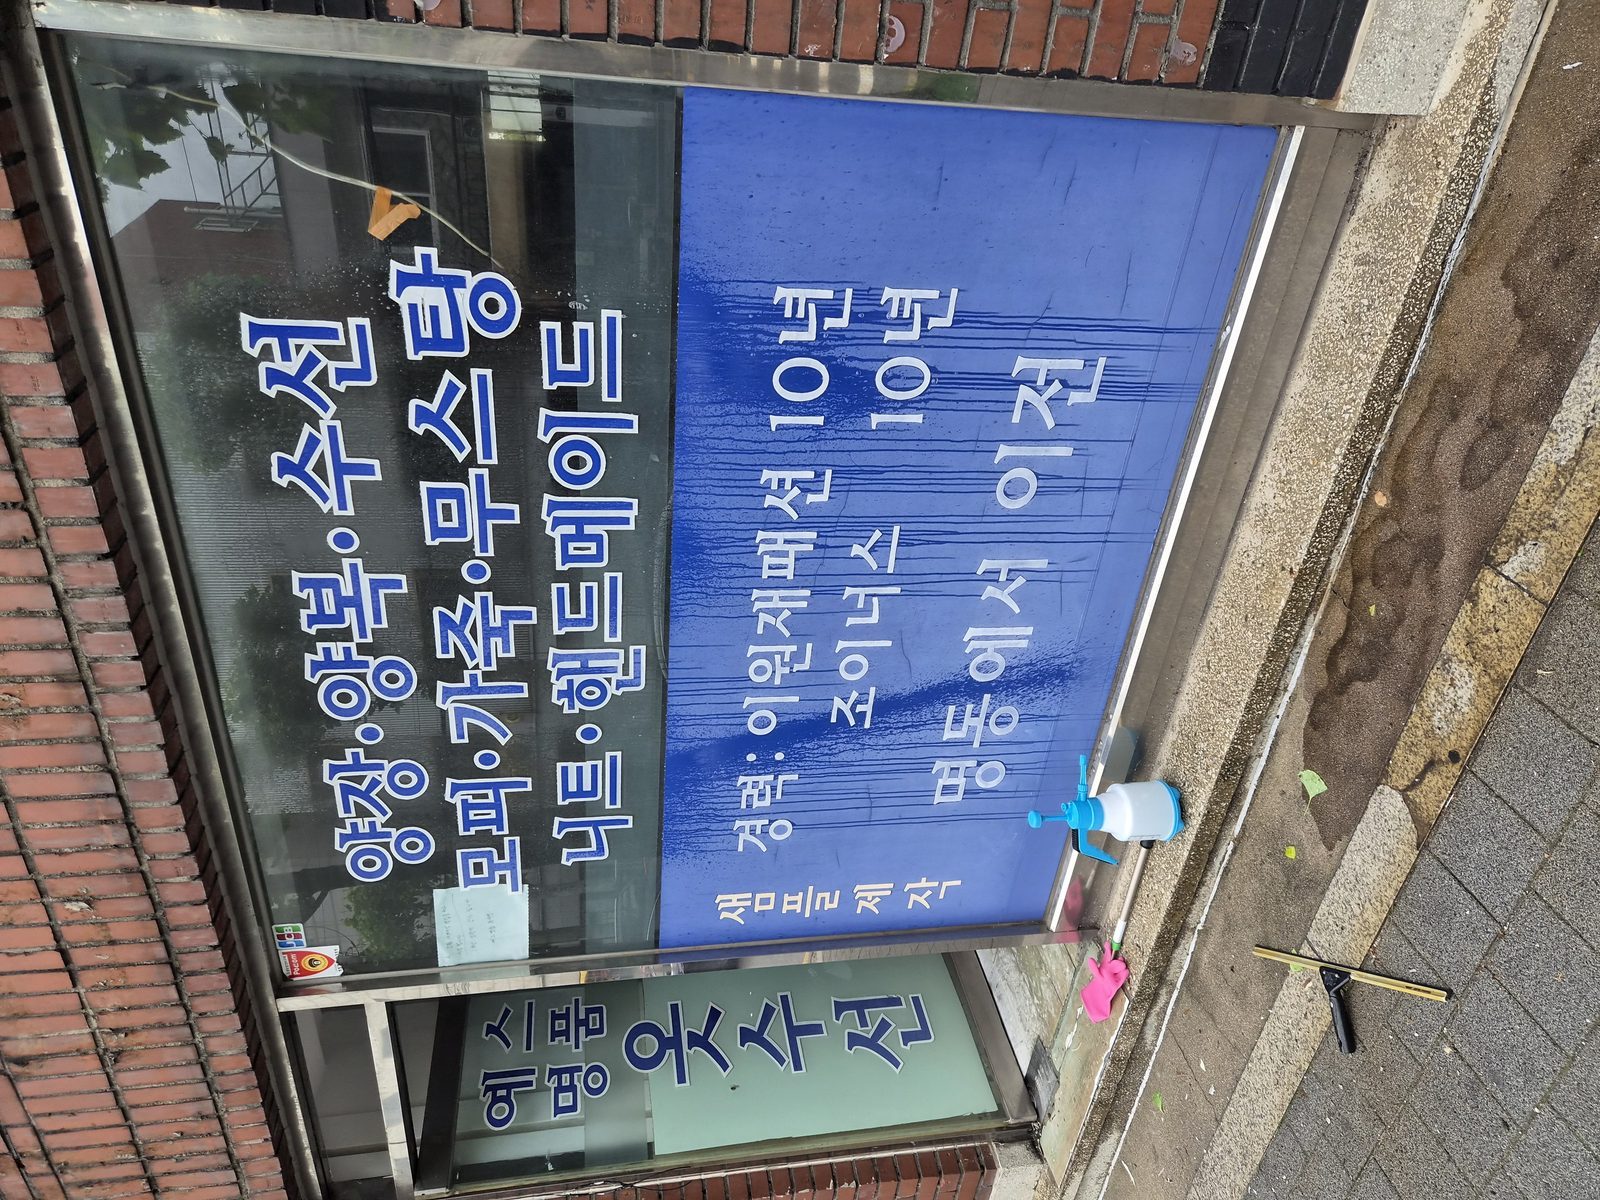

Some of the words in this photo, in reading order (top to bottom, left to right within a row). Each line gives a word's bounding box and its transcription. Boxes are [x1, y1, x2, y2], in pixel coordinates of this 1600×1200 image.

[733, 751, 799, 852] 경력:
[769, 286, 853, 431] 10년
[830, 525, 901, 729] 조이너스
[870, 286, 958, 430] 10년
[931, 559, 1049, 805] 명동에서
[993, 355, 1107, 510] 이전
